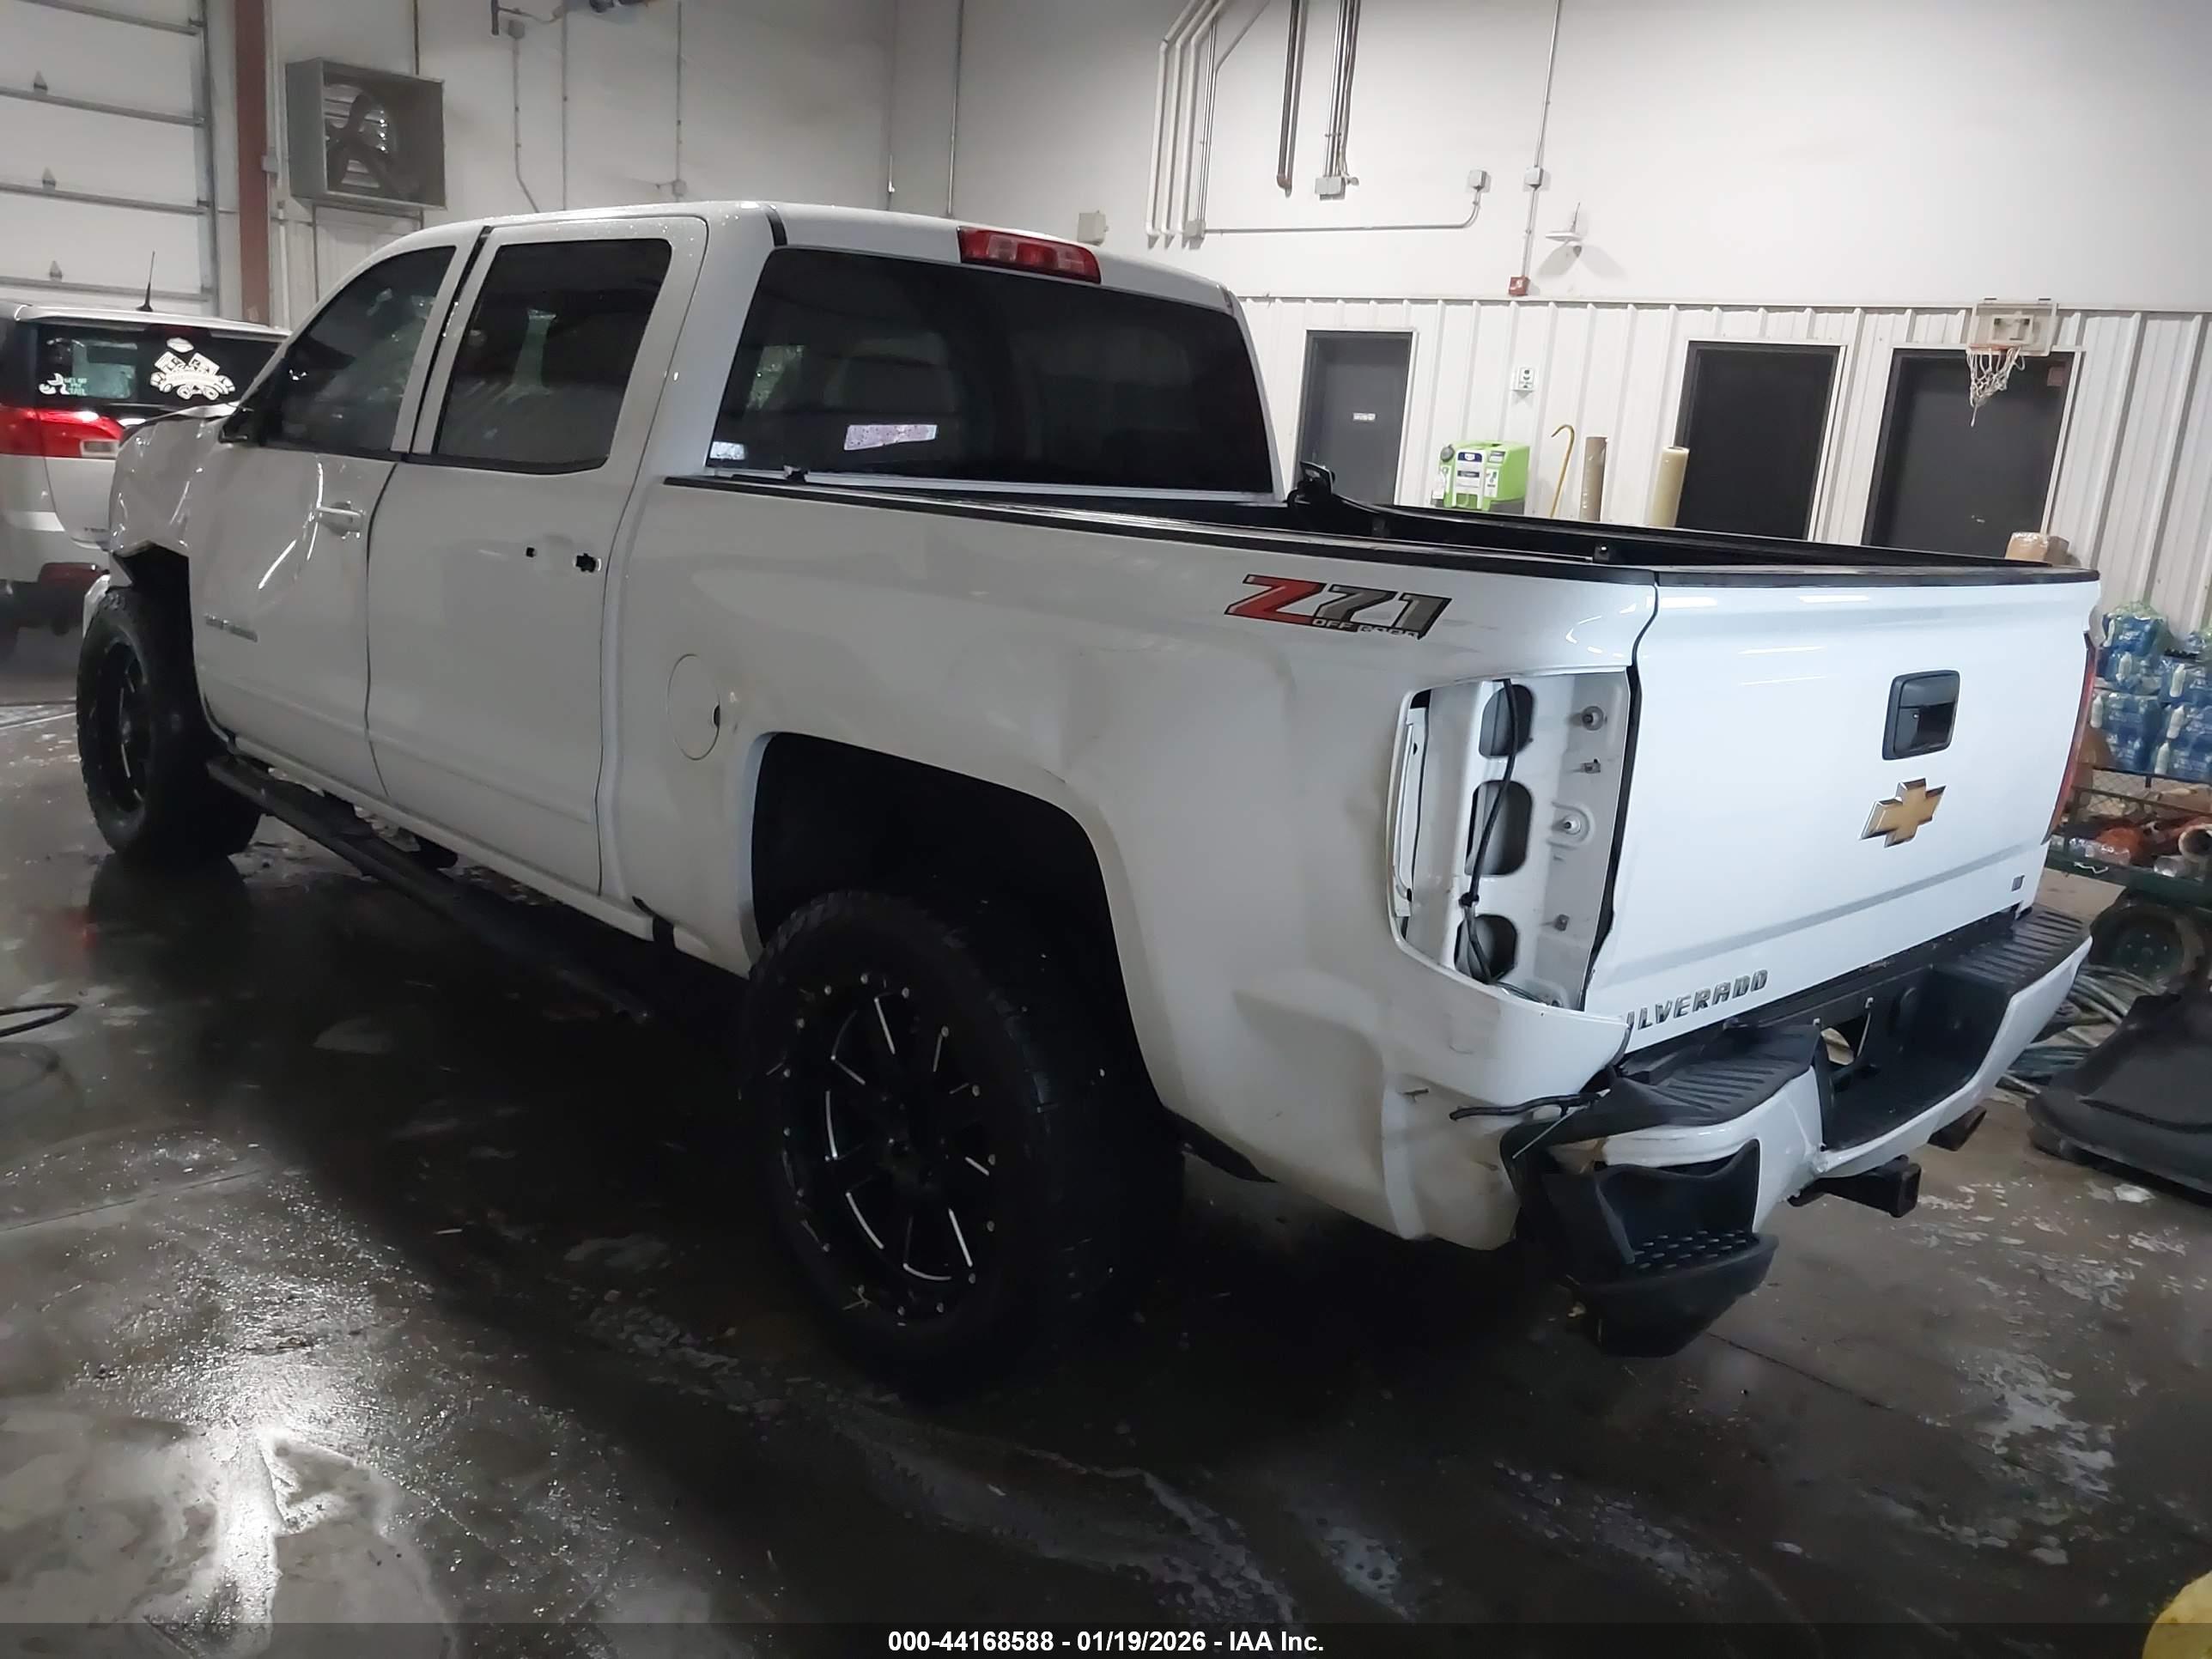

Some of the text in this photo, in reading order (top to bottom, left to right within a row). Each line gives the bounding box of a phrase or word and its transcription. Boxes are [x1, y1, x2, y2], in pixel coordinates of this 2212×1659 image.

[1224, 574, 1453, 640] Z71
[1312, 618, 1354, 629] OFF
[1626, 969, 1768, 1030] ILVERADO
